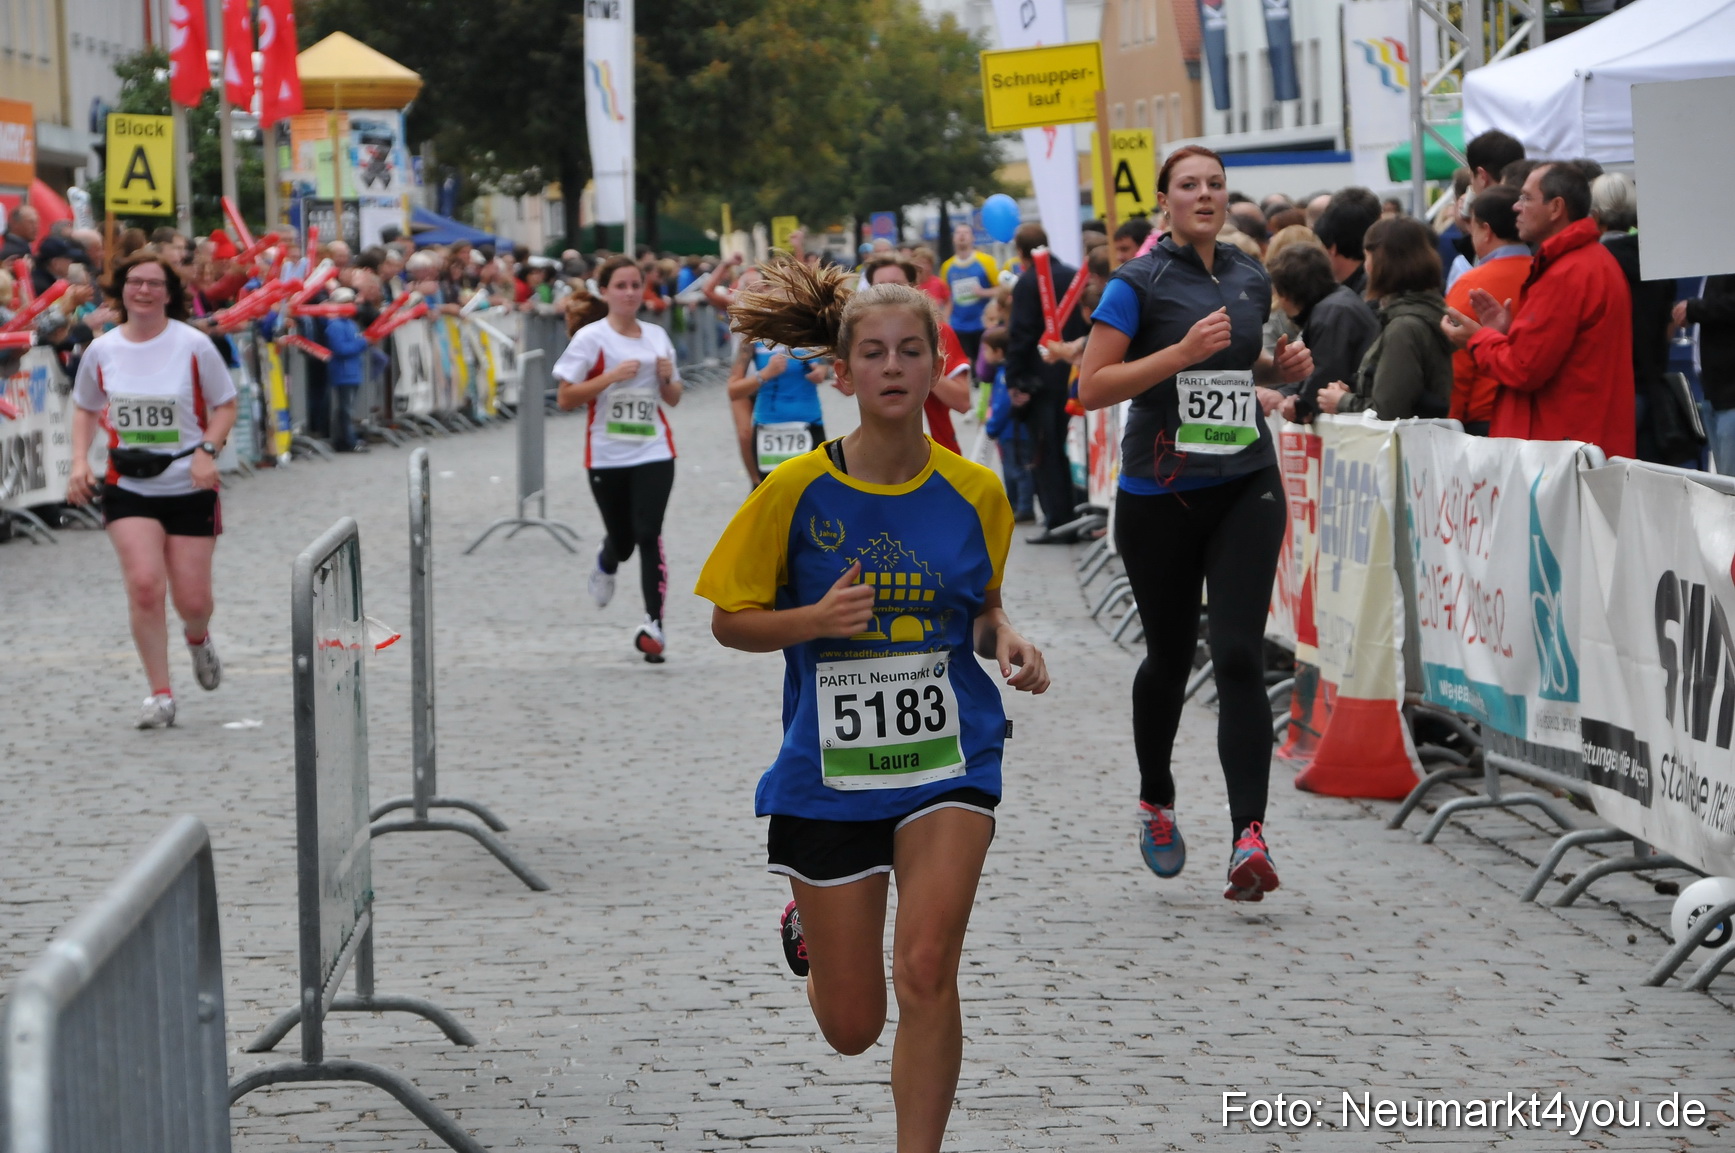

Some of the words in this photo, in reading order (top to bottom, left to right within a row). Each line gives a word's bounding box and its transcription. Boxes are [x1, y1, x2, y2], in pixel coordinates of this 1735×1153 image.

[992, 67, 1094, 89] Schnupper-
[1028, 89, 1061, 107] lauf
[114, 118, 165, 137] Block
[1110, 132, 1148, 150] lock
[120, 144, 156, 191] A
[1112, 157, 1142, 203] A
[1179, 377, 1208, 386] PARTL
[1211, 378, 1249, 387] Neumarkt
[1188, 390, 1251, 421] 5217
[117, 406, 174, 427] 5189
[763, 433, 806, 452] 5178
[819, 530, 838, 539] Jahre
[819, 673, 866, 687] PARTL
[869, 667, 930, 684] Neumarkt
[834, 685, 946, 741] 5183
[826, 739, 832, 748] S
[868, 752, 920, 770] Laura
